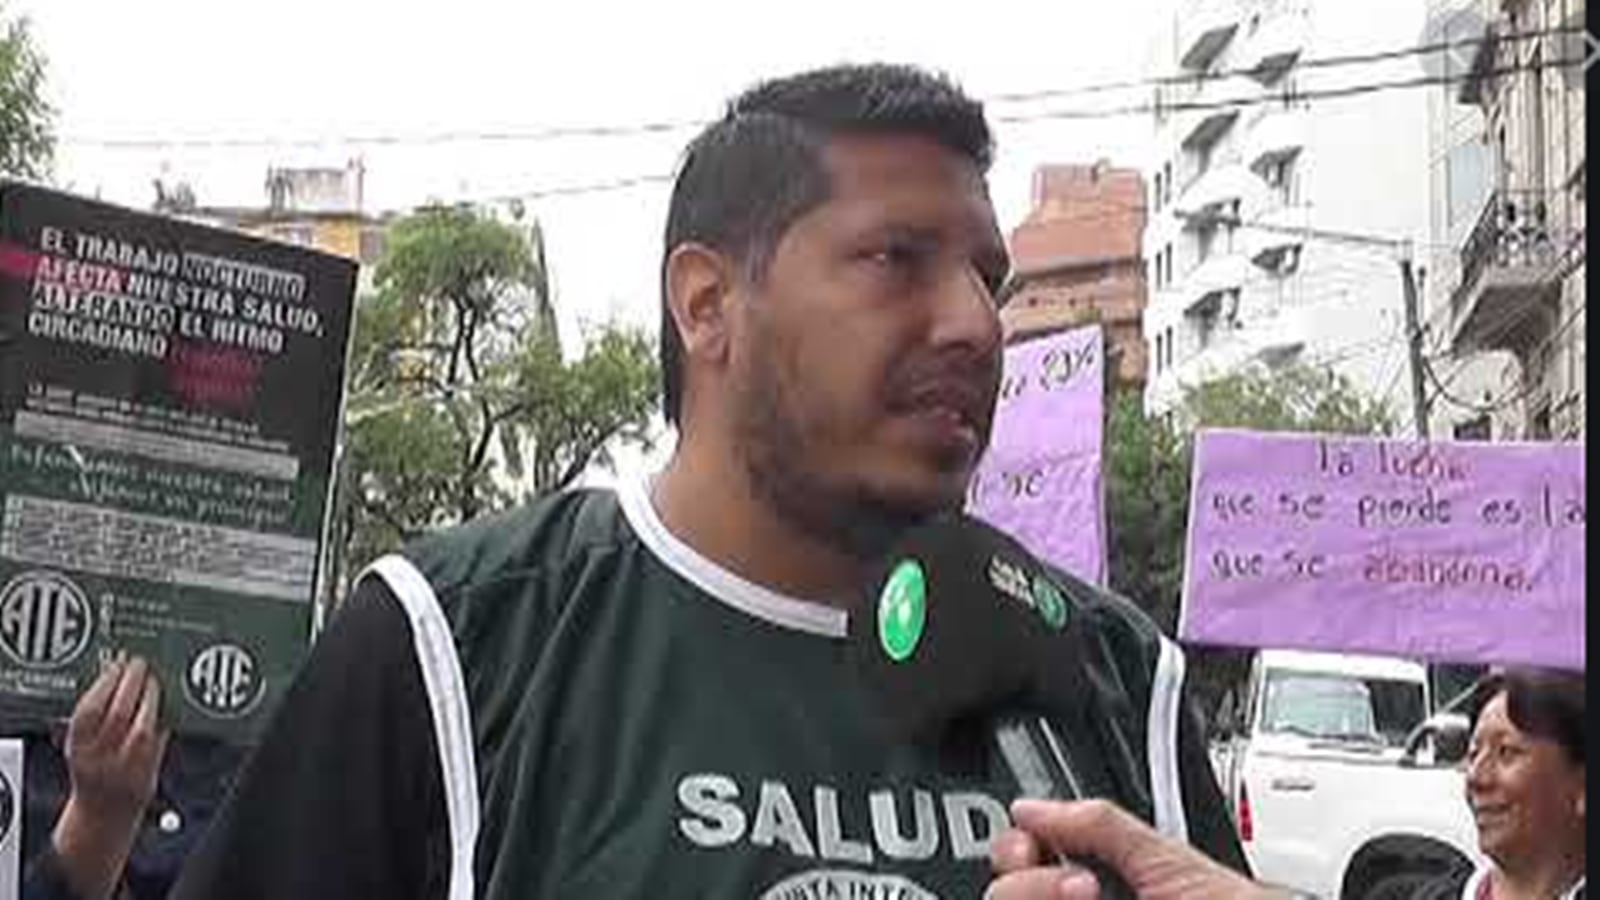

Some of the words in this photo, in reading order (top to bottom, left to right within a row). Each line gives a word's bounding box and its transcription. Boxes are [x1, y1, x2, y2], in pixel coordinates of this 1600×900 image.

[75, 233, 180, 273] TRABAJO
[35, 256, 124, 293] AFECTA
[127, 272, 236, 317] NUESTRA
[28, 311, 168, 359] CIRCADIANO
[179, 310, 207, 337] EL
[211, 318, 285, 354] RITMO
[1357, 487, 1452, 527] pierde
[1481, 499, 1522, 525] es
[2, 580, 80, 660] ATE
[191, 644, 252, 707] ATE
[677, 773, 1011, 863] SALUD
